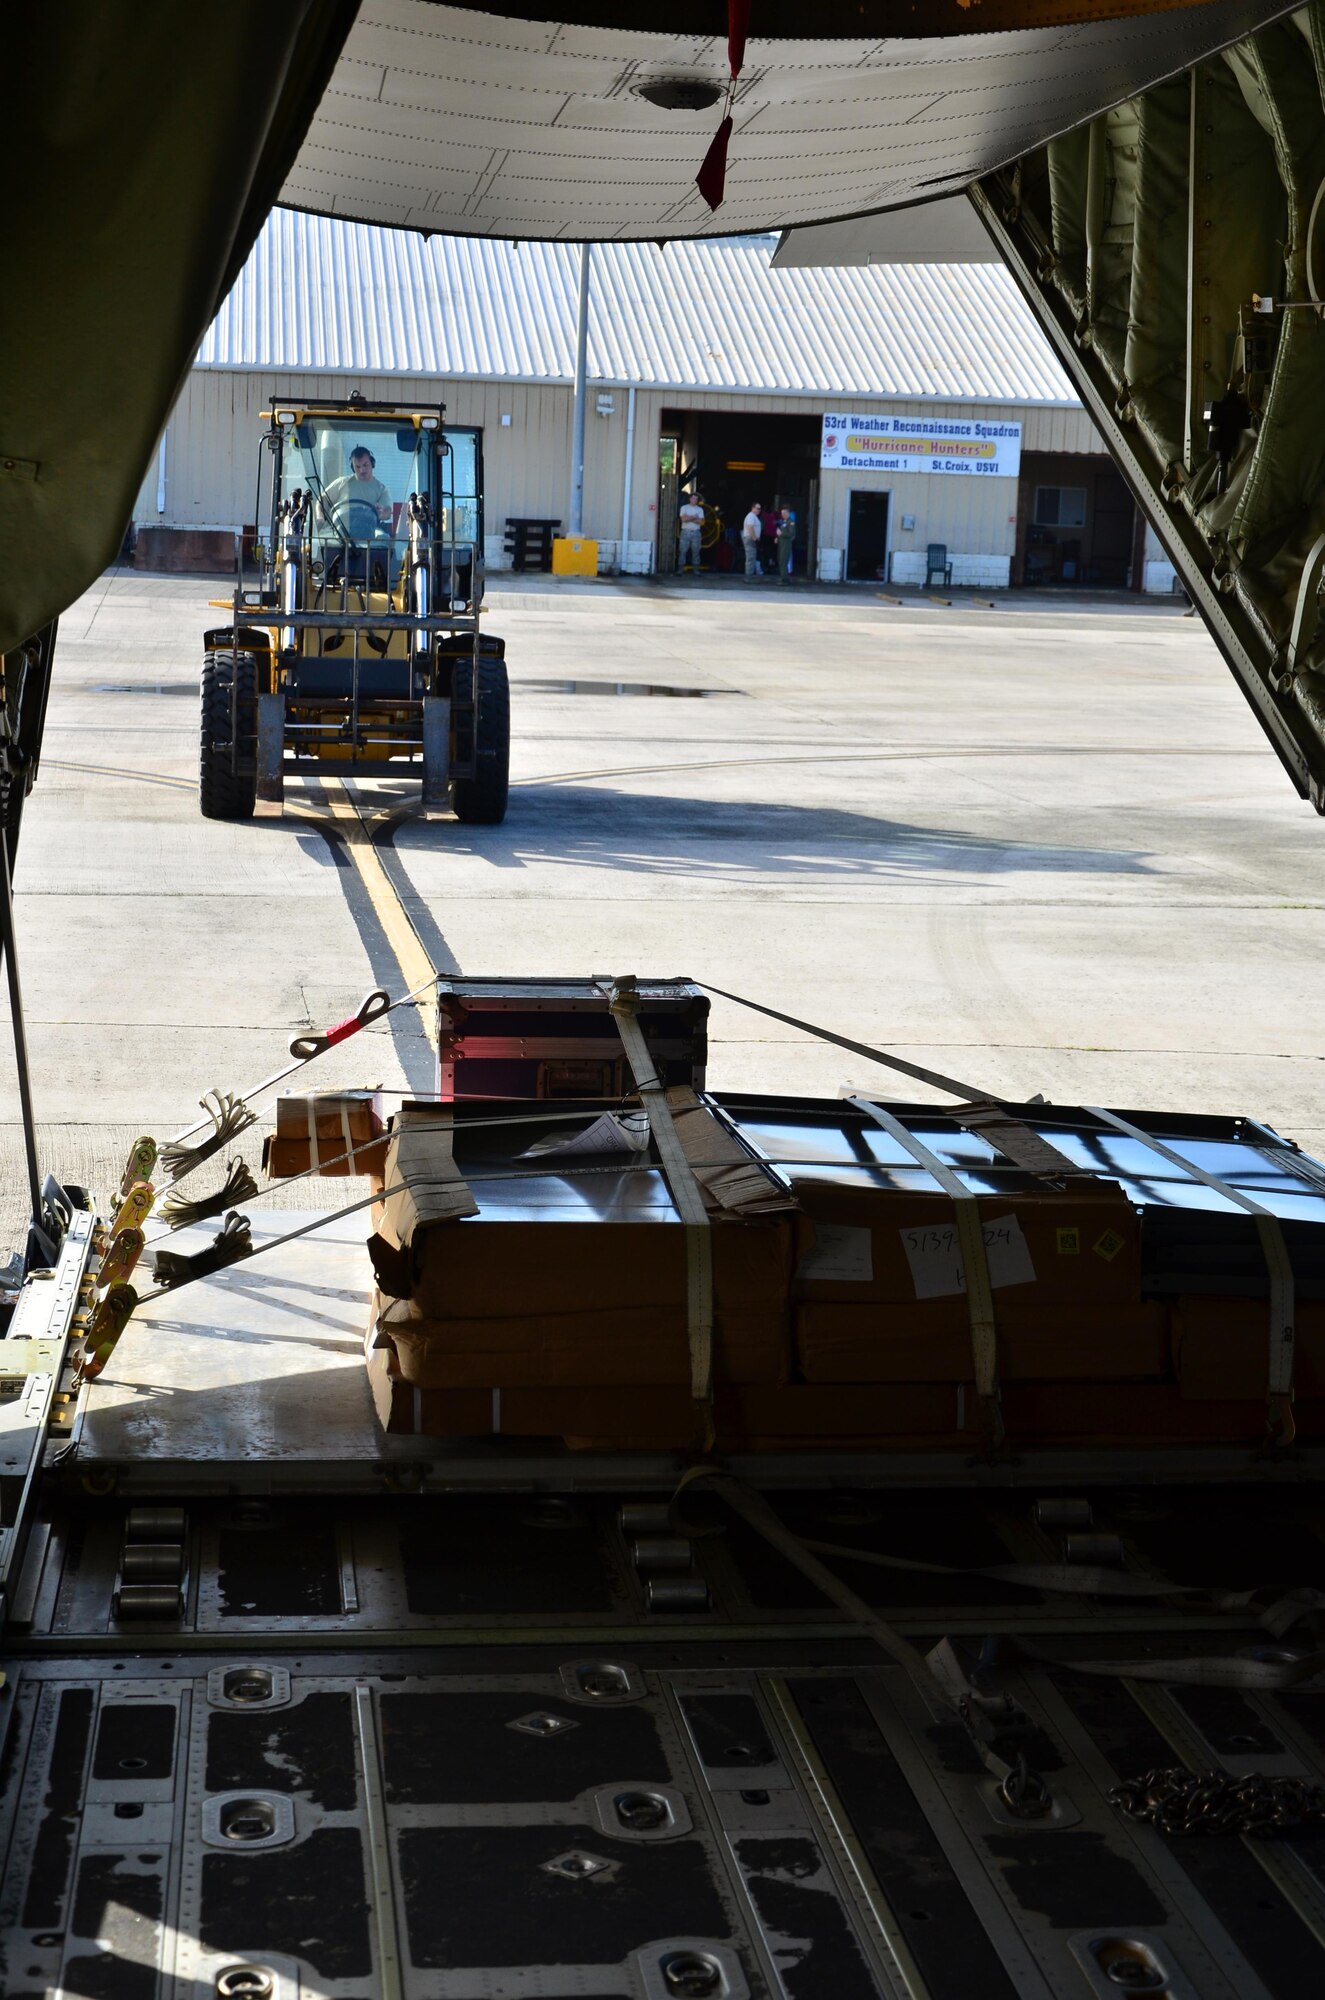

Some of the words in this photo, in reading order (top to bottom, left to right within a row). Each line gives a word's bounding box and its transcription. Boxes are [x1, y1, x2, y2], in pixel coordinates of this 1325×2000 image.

[825, 416, 847, 429] 53rd
[851, 417, 889, 431] Weather
[893, 419, 971, 435] Reconnaissance
[975, 423, 1019, 438] Squadron
[855, 438, 924, 452] "Hurricane
[930, 441, 988, 455] Hunters"
[841, 456, 899, 468] Detachment
[903, 459, 908, 468] 1
[976, 462, 999, 472] USVI
